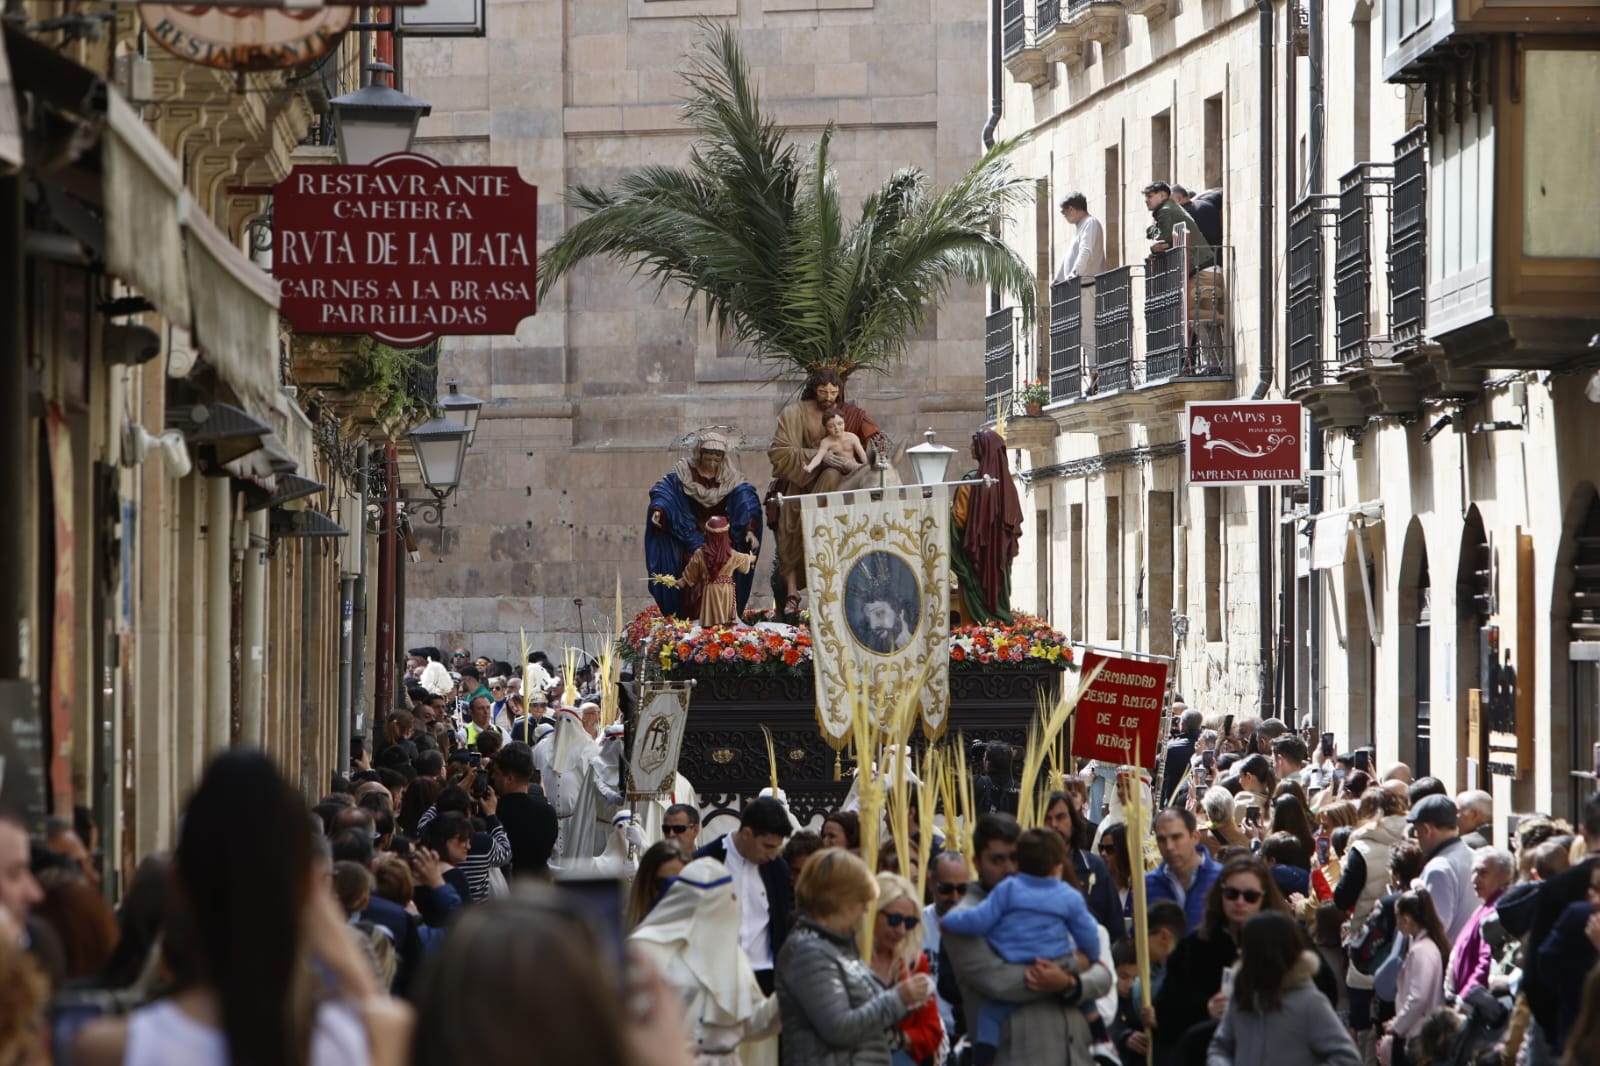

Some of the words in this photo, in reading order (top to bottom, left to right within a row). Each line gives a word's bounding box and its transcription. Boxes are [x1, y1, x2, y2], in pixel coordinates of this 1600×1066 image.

[297, 173, 512, 197] RESTAVRANTE
[280, 230, 356, 266] RVTA
[366, 231, 399, 266] DE
[408, 231, 441, 266] LA
[450, 232, 531, 267] PLATA
[280, 278, 379, 299] CARNES
[386, 279, 403, 299] A
[412, 279, 441, 300] LA
[450, 280, 531, 301] BRASA
[1271, 414, 1282, 426] 13
[1095, 669, 1157, 689] ERMANDAD
[1083, 688, 1118, 705] JESUS
[1121, 694, 1158, 710] AMIGO
[1096, 712, 1112, 726] DE
[1119, 715, 1139, 729] LOS
[1095, 733, 1133, 750] NIÑOS
